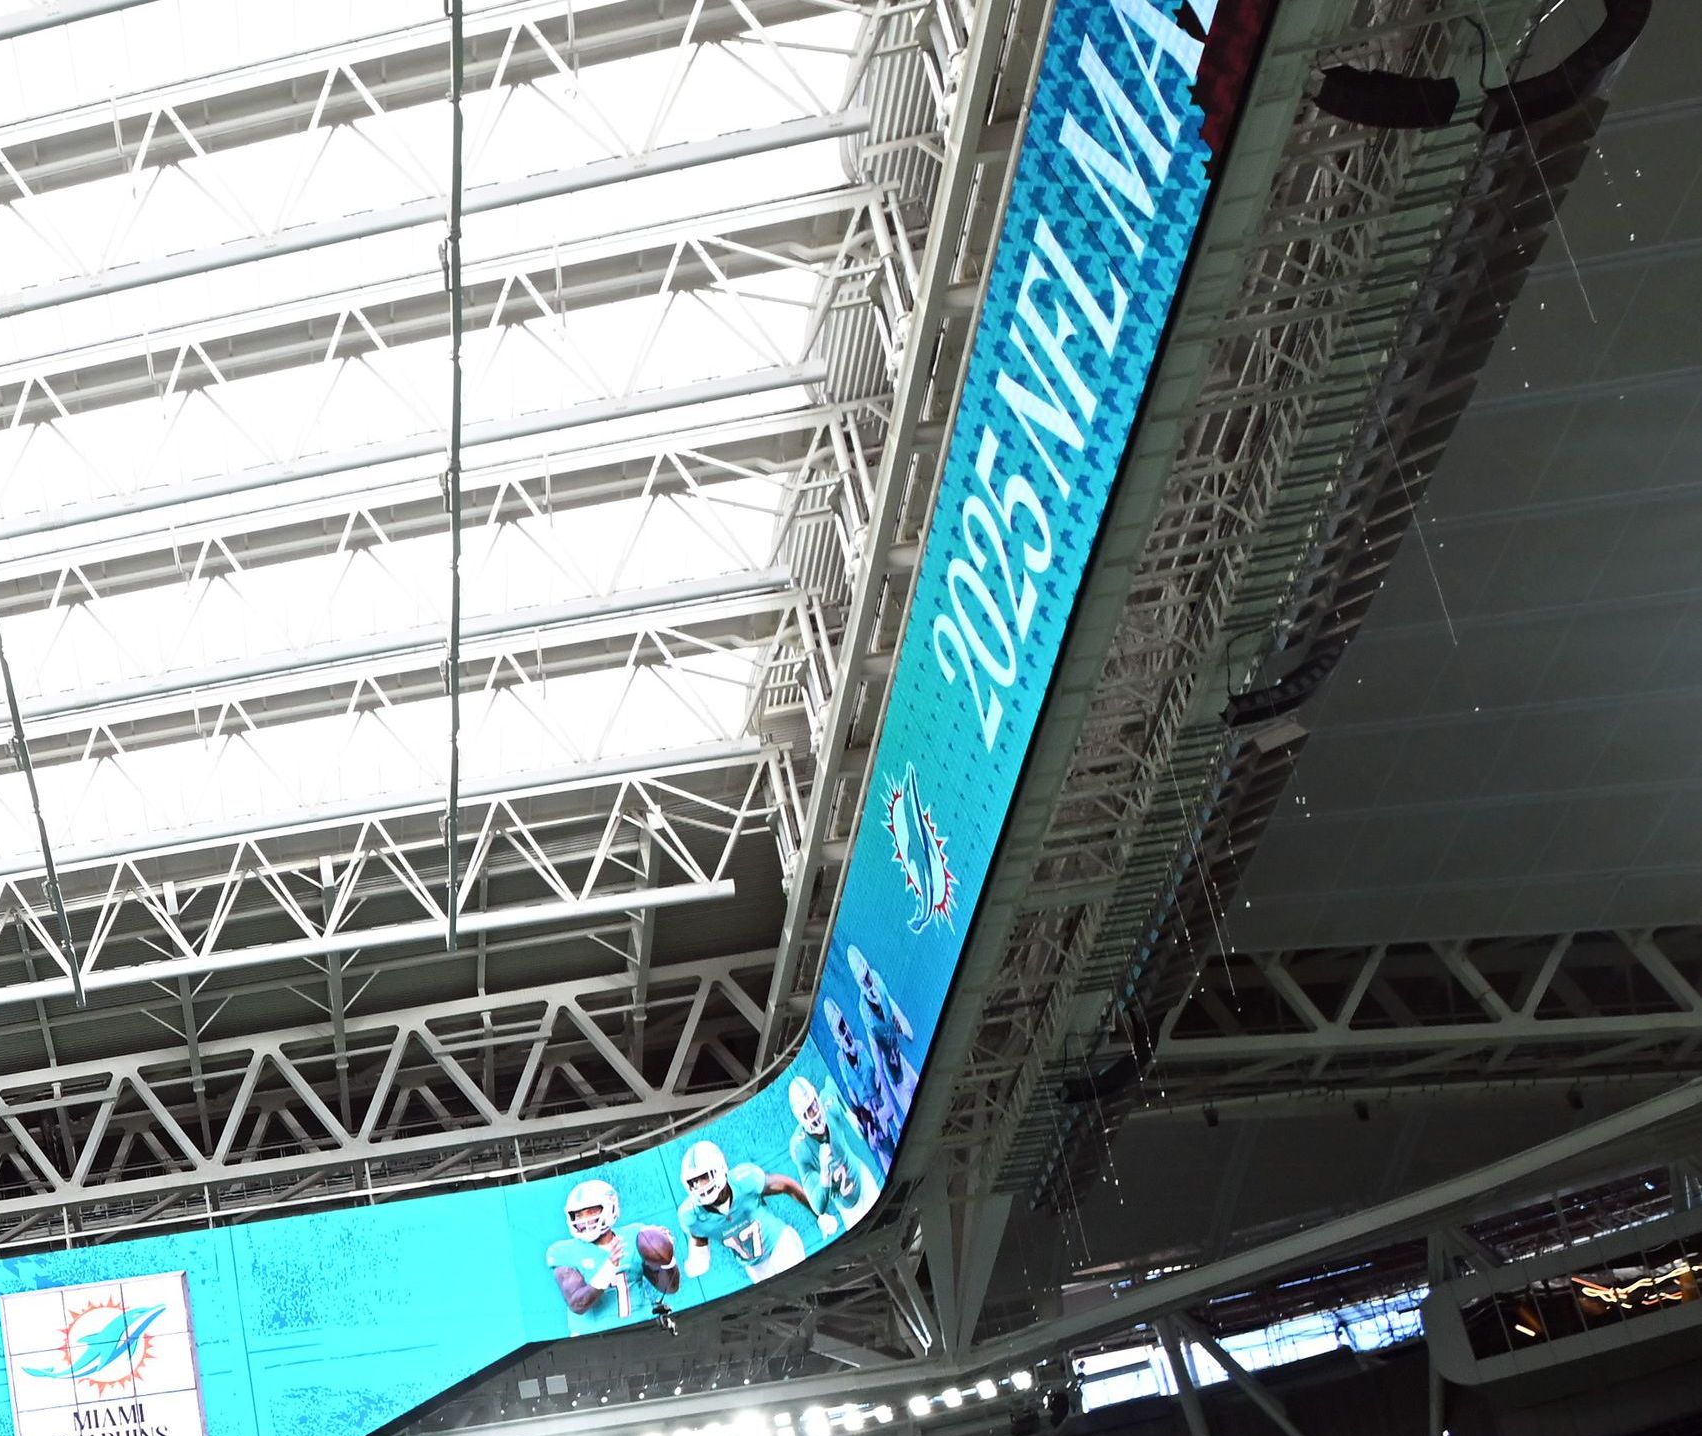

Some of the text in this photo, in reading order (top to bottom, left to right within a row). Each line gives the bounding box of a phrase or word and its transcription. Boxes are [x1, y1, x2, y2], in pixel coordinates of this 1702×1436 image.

[932, 213, 1128, 753] 2025 NFL
[722, 1221, 763, 1260] 17
[73, 1403, 145, 1431] MIAMI
